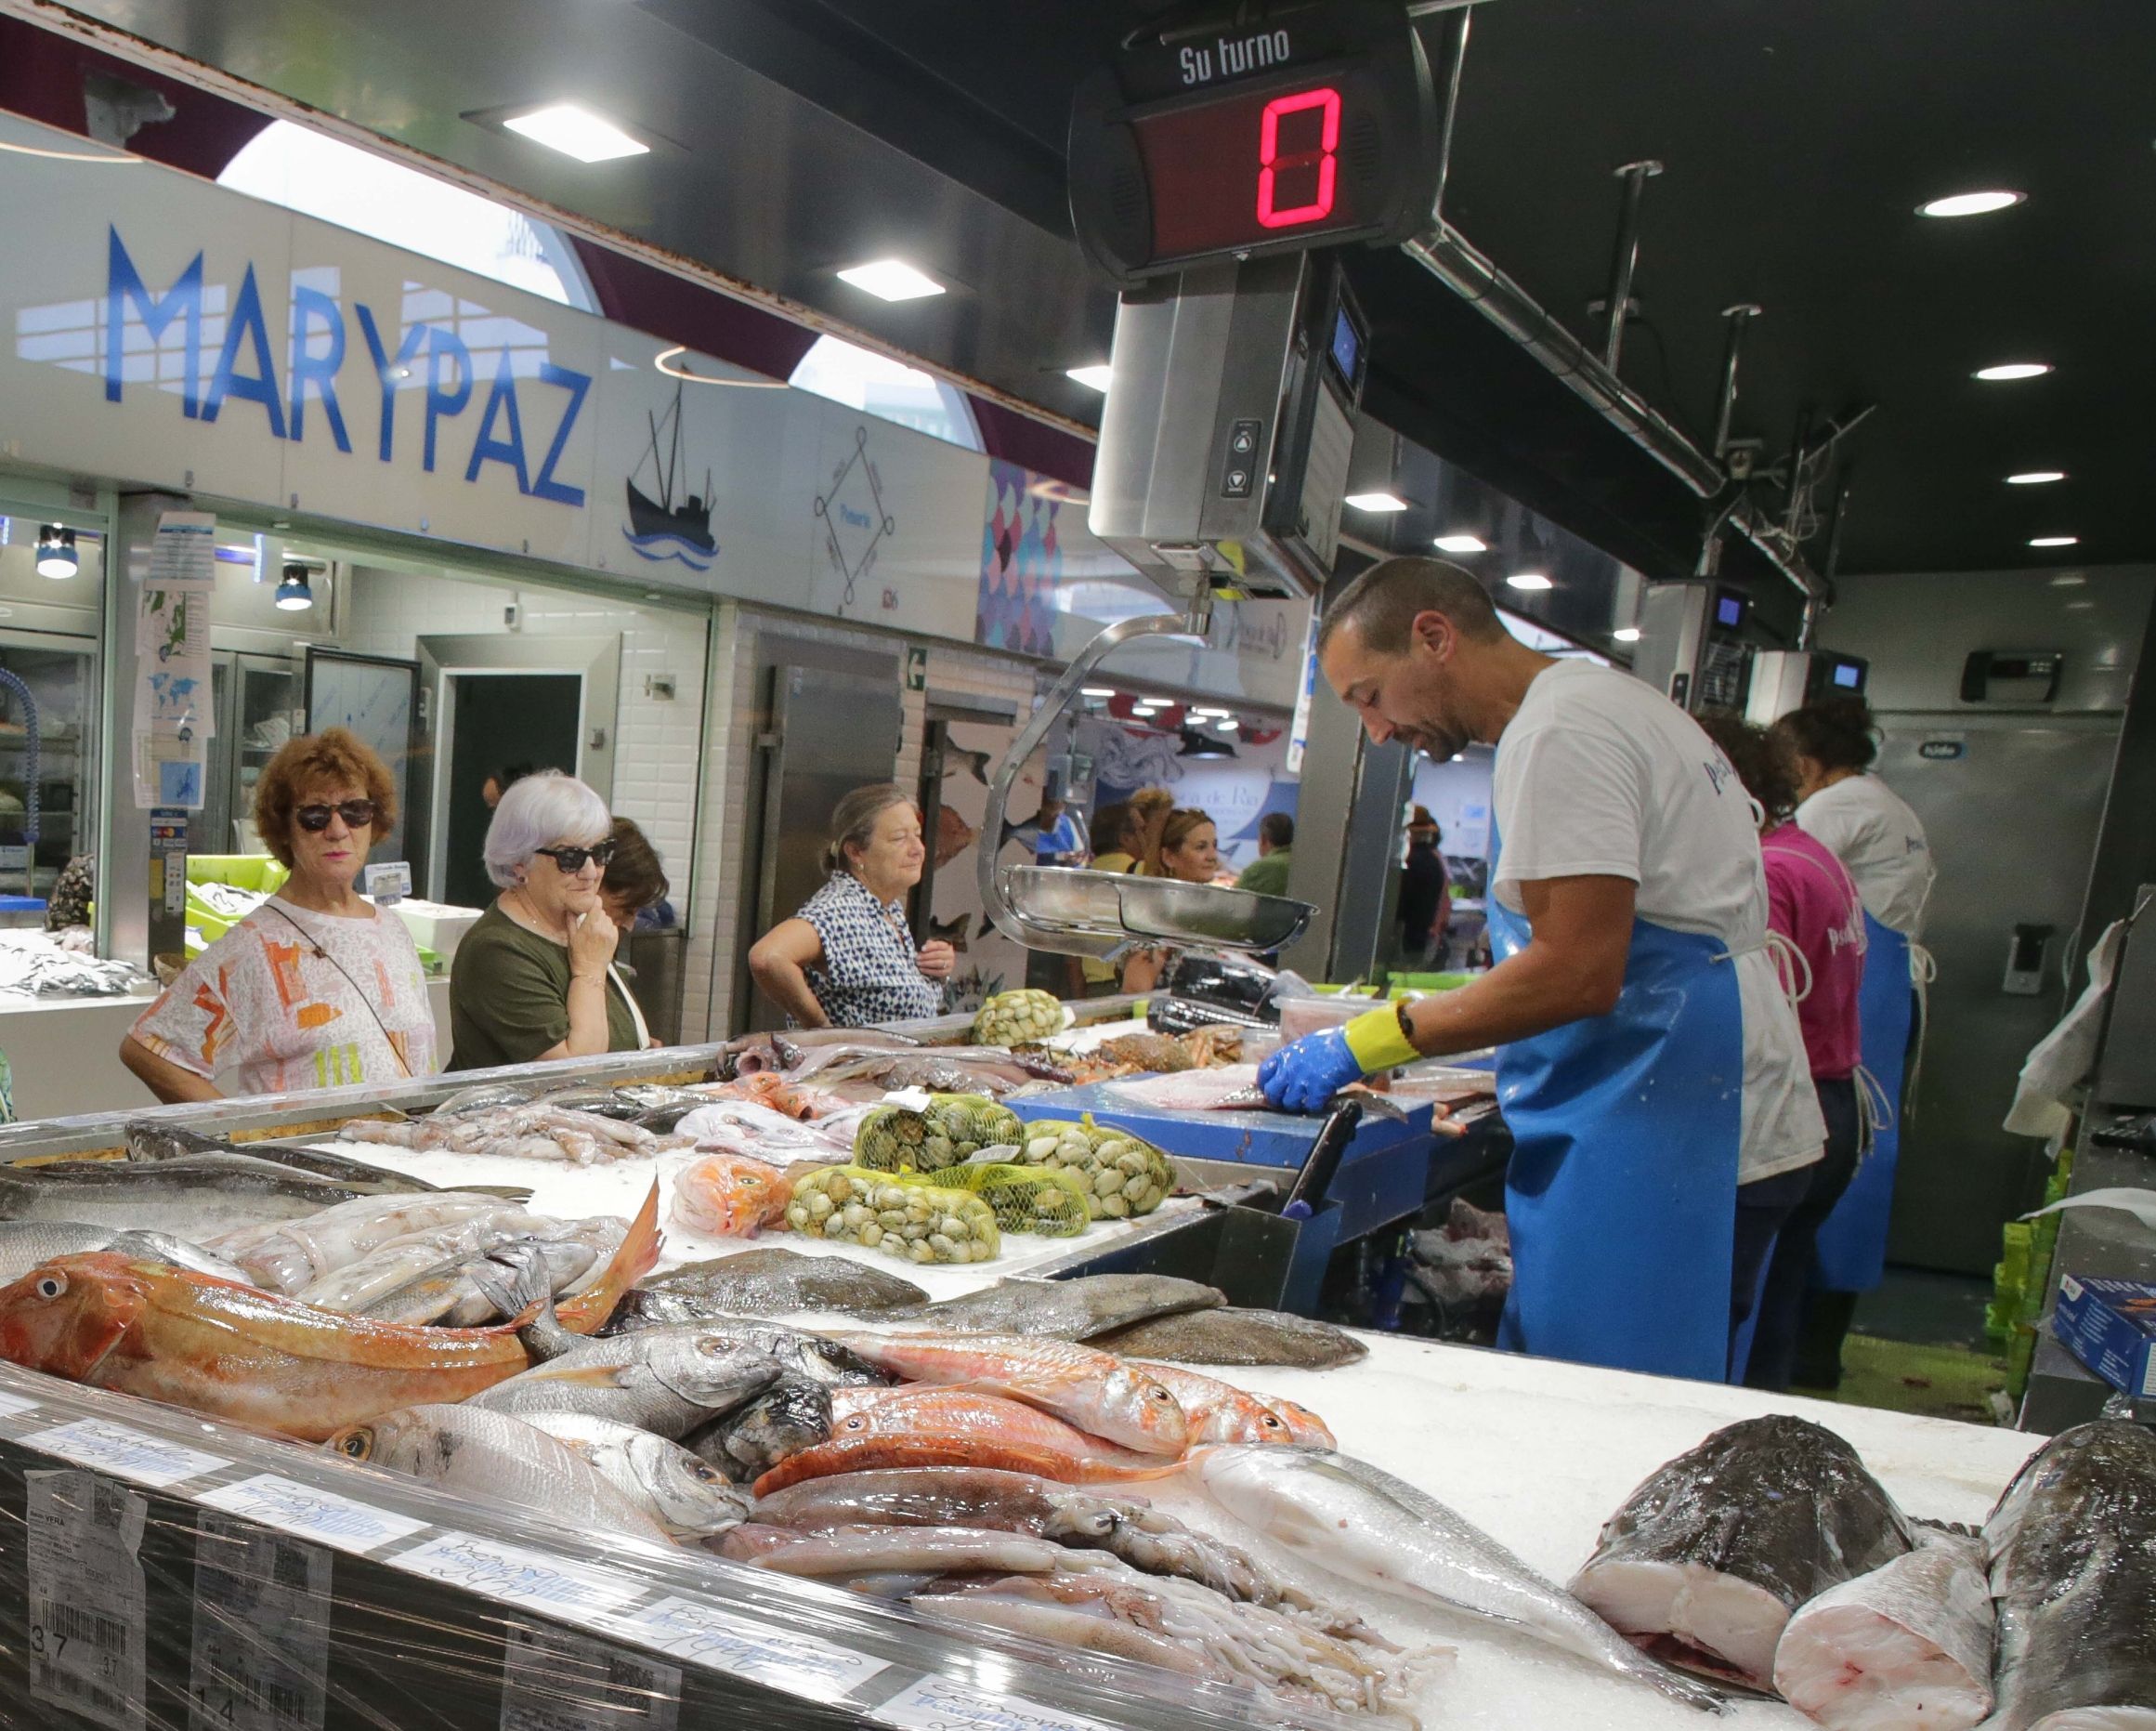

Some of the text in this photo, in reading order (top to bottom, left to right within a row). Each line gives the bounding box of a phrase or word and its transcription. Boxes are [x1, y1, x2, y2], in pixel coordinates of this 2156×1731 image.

[1180, 30, 1290, 85] Su turno
[1257, 87, 1341, 229] 0
[106, 223, 593, 507] MARYPAZ
